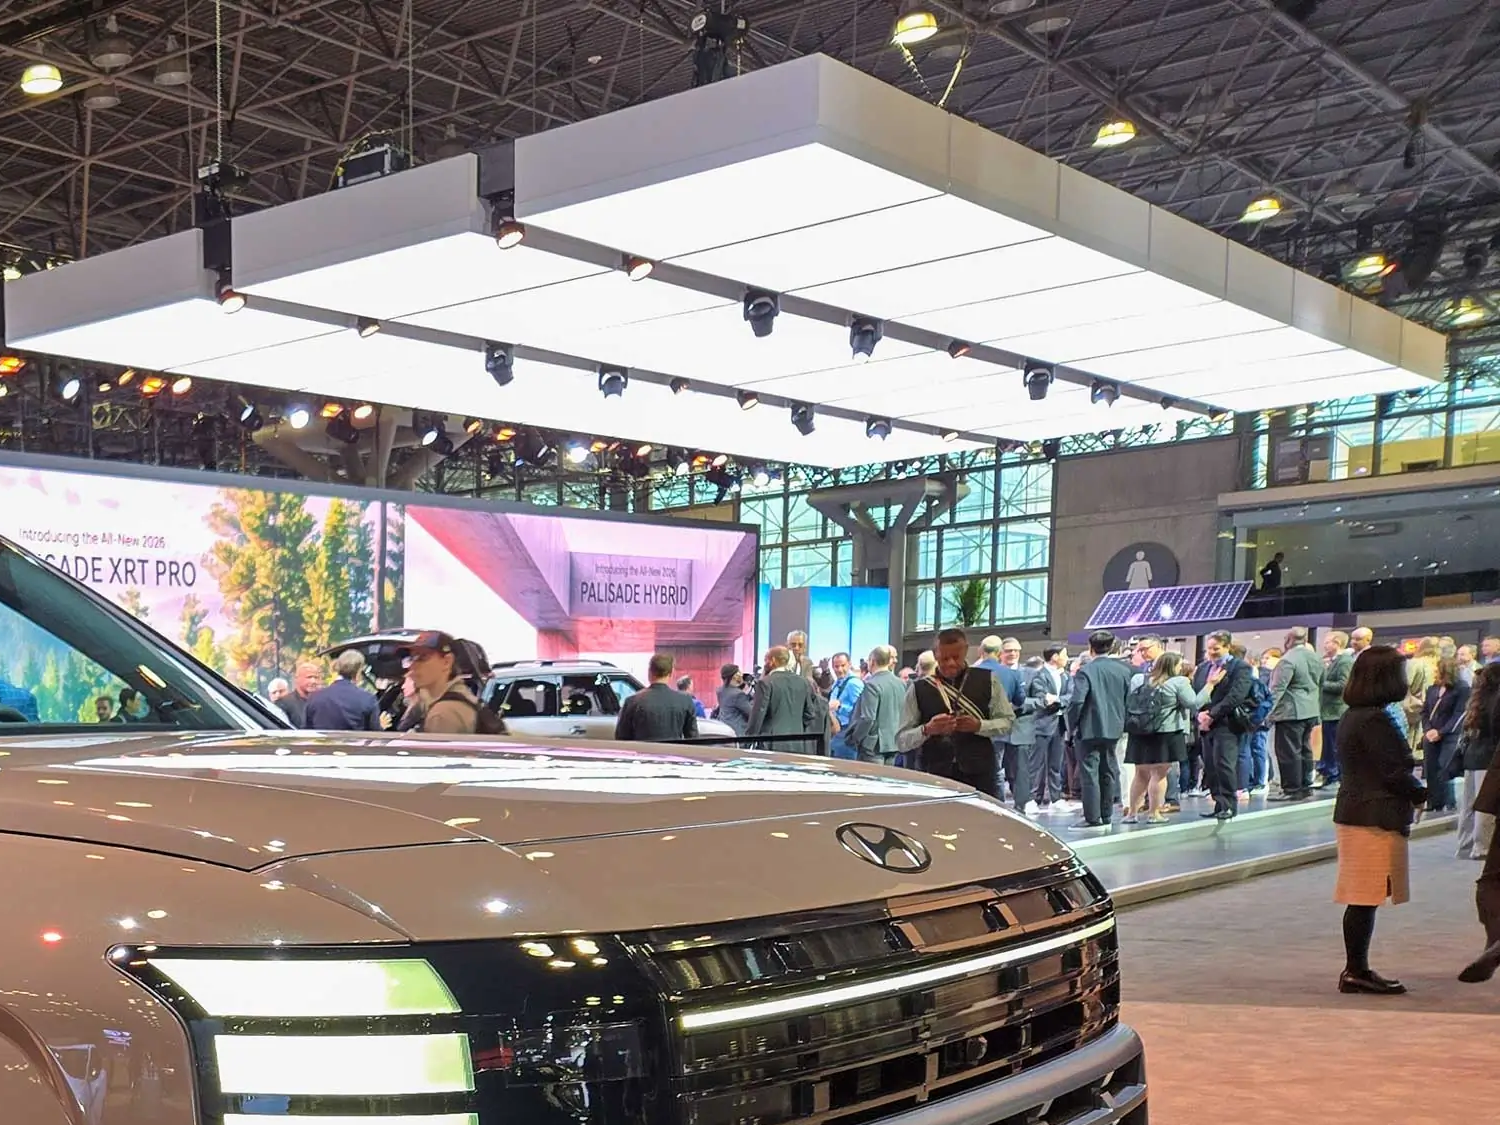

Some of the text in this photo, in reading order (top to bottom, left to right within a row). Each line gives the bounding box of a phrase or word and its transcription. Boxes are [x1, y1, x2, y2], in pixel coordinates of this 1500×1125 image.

[18, 528, 166, 549] Introducing the All-New 2026
[108, 557, 149, 585] XRT
[155, 560, 197, 587] PRO
[595, 564, 677, 578] Introducing the All-New 2026
[580, 581, 688, 606] PALISADE HYBRID
